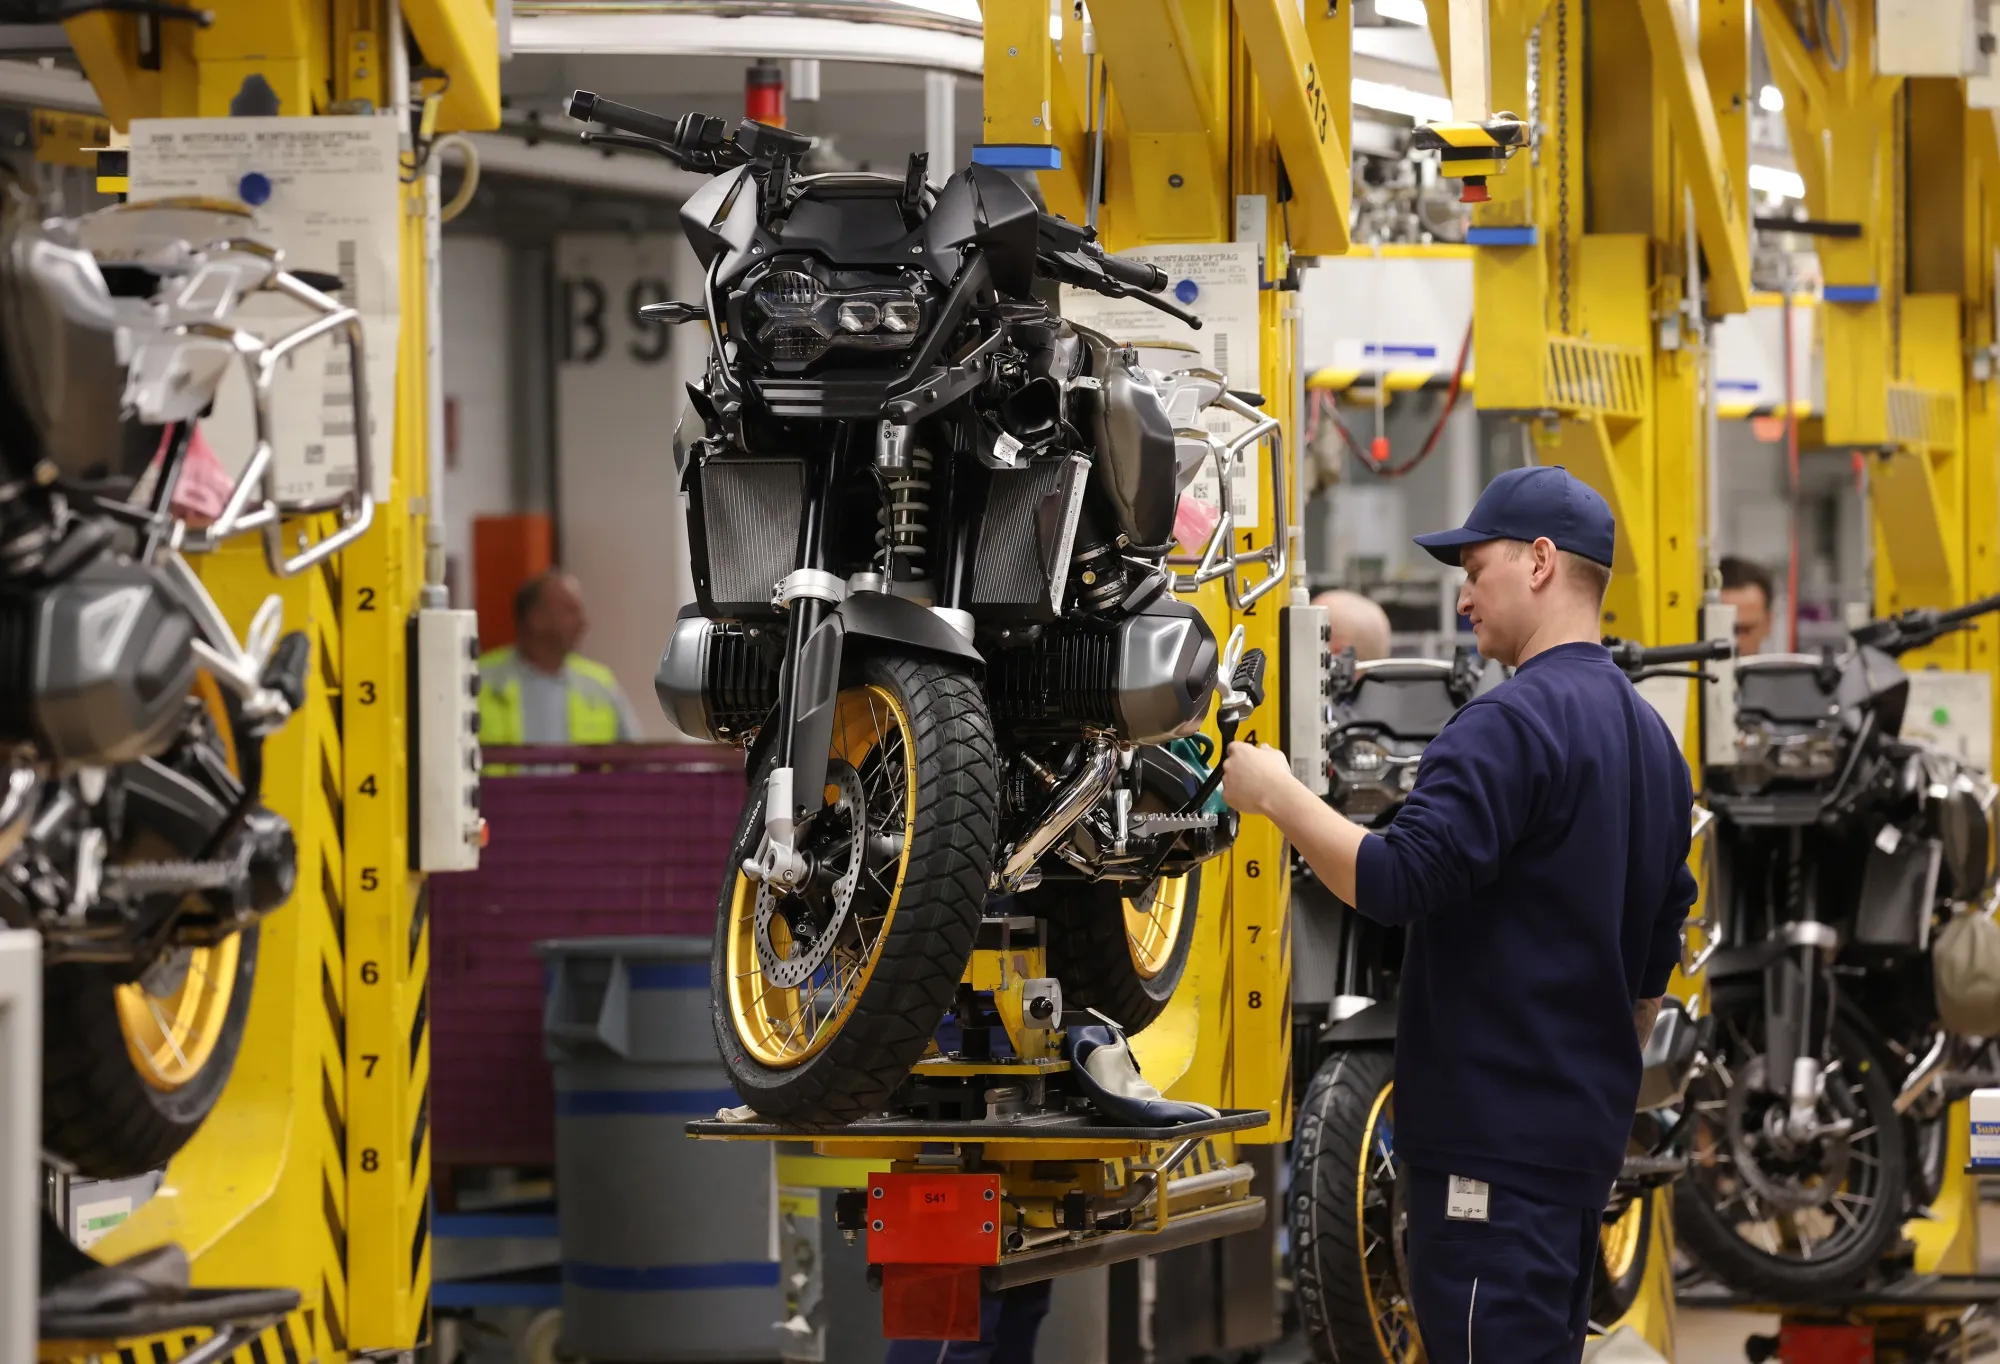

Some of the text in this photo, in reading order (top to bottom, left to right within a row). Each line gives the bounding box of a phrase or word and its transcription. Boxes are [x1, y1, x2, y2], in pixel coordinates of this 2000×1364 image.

[1306, 62, 1327, 145] 213
[1243, 532, 1253, 550] 1
[357, 586, 377, 612] 2
[358, 680, 377, 706] 3
[1243, 729, 1258, 747] 4
[358, 774, 379, 798] 4
[740, 800, 762, 848] brembo
[360, 867, 379, 892] 5
[1246, 860, 1260, 879] 6
[1247, 925, 1262, 944] 7
[360, 961, 380, 985] 6
[1248, 991, 1262, 1009] 8
[360, 1055, 380, 1079] 7
[360, 1148, 380, 1172] 8
[924, 1193, 946, 1204] S41
